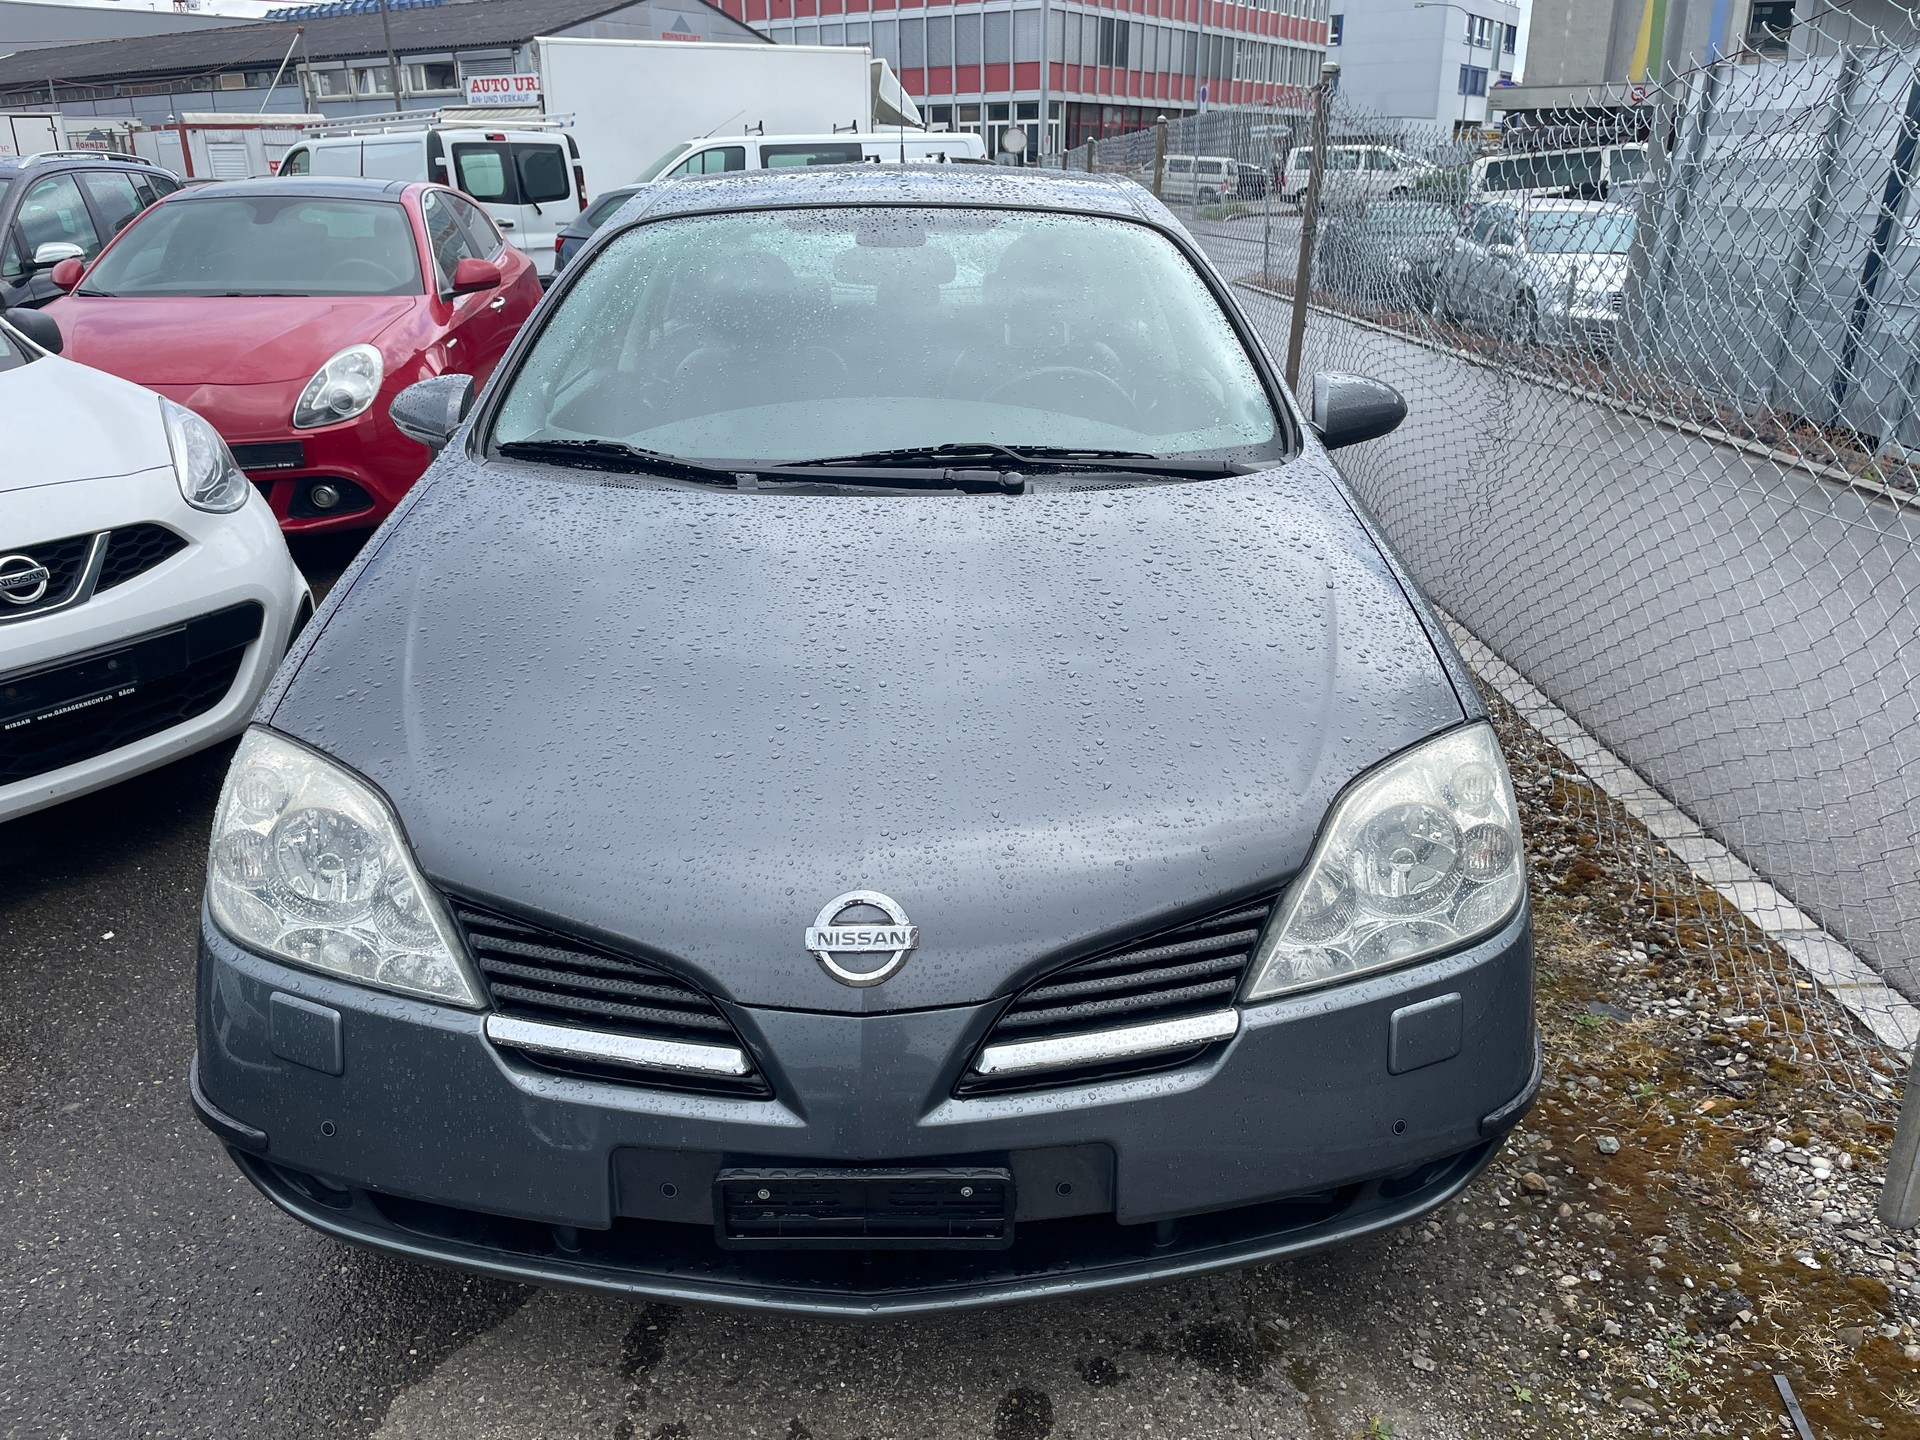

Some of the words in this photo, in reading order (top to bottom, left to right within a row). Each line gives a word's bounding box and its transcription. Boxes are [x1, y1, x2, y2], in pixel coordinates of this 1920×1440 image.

[470, 77, 510, 93] AUTO
[483, 95, 498, 104] UND
[500, 93, 530, 103] VERKAUF
[0, 570, 46, 587] NISSAN
[5, 718, 31, 730] NISSAN
[37, 694, 113, 721] www.GARAGEKNECHT.ch
[817, 931, 906, 946] NISSAN
